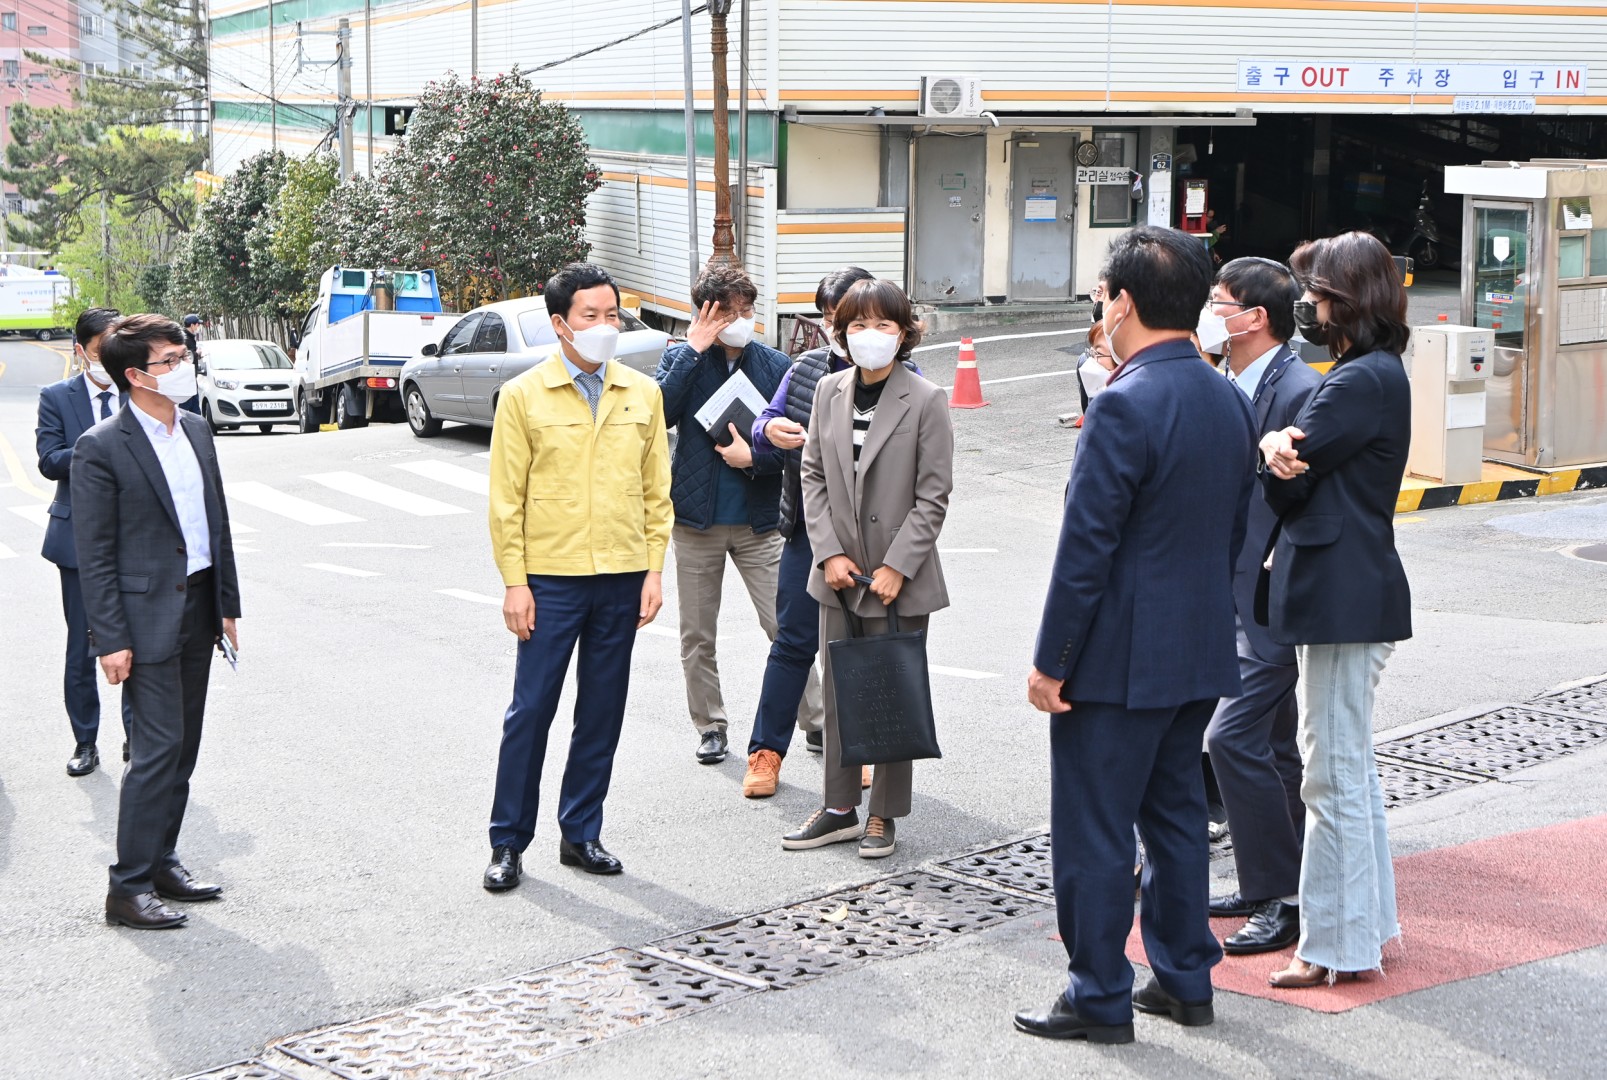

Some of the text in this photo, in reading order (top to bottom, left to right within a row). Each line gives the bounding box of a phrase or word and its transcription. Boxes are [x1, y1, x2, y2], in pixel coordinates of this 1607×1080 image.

[1245, 66, 1580, 89] 출구 OUT 주차장 입구 IN
[1156, 161, 1167, 169] 62
[1078, 169, 1108, 183] 관리실
